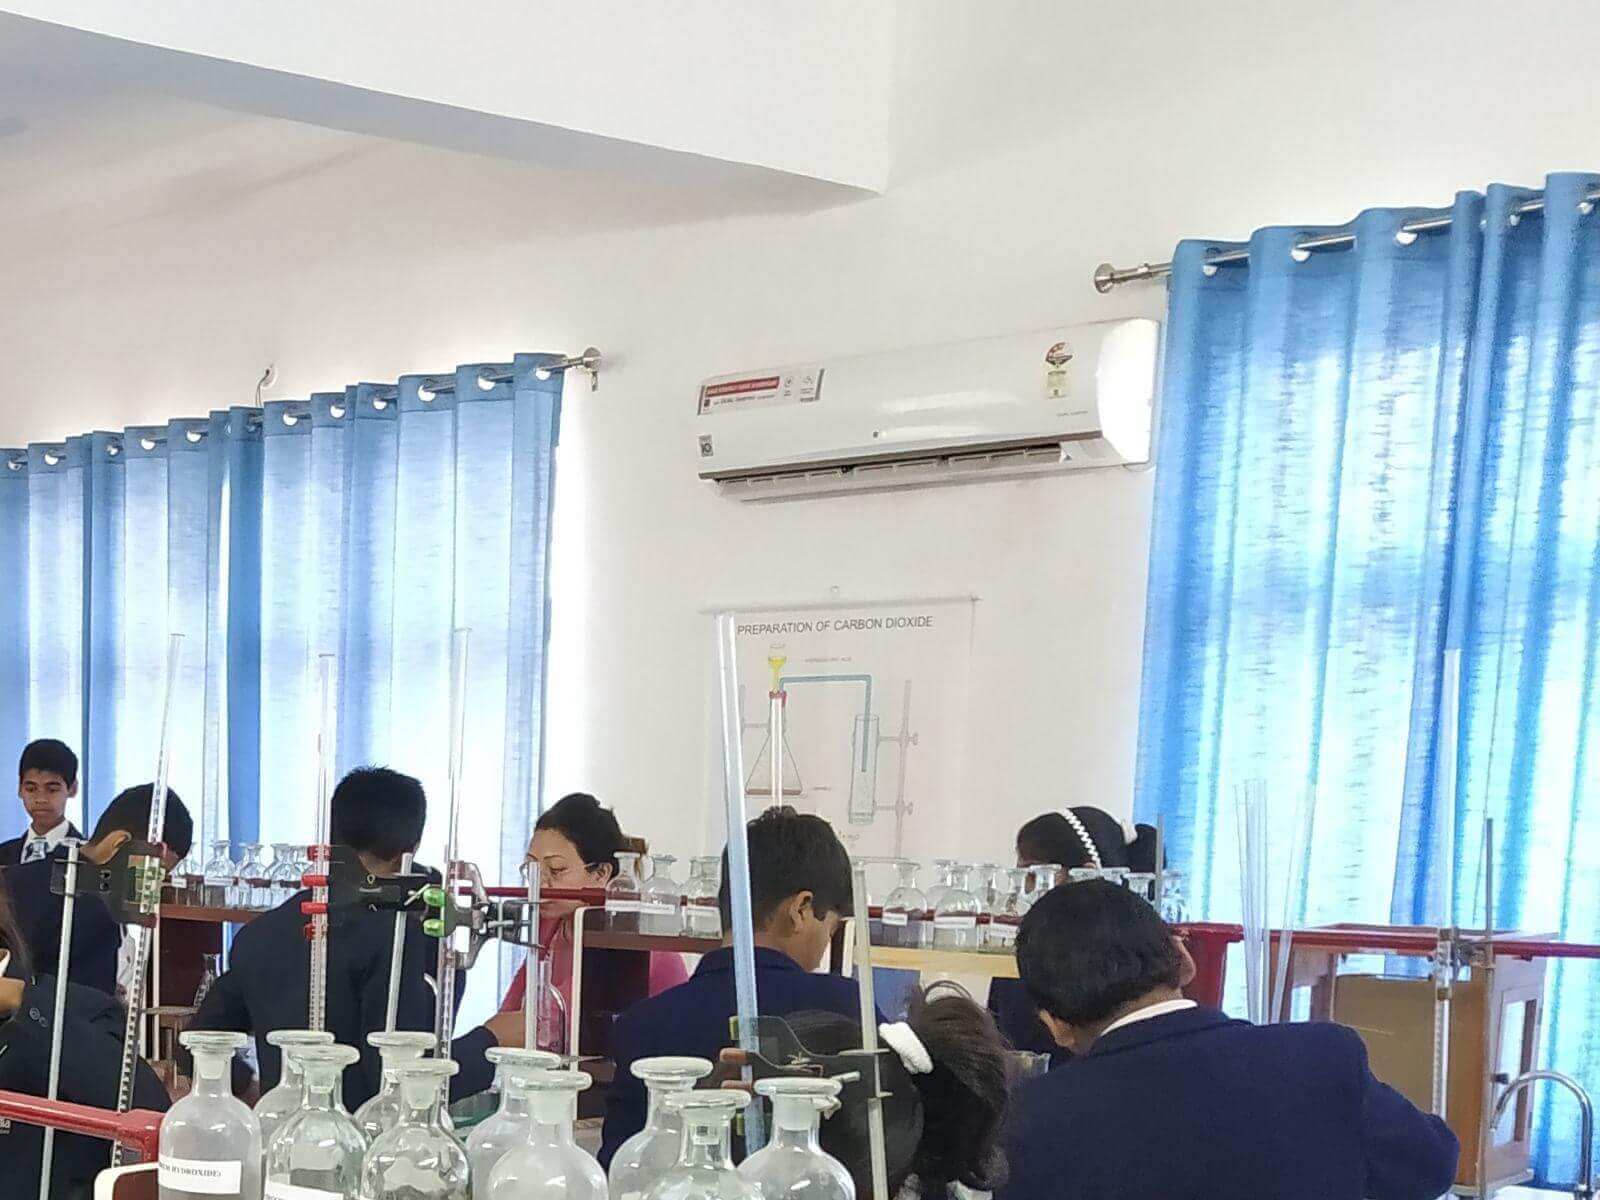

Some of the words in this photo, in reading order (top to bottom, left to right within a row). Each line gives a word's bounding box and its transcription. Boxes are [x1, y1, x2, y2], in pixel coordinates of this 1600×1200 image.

[737, 622, 812, 635] PREPARATION
[815, 621, 830, 632] OF
[834, 618, 882, 631] CARBON
[885, 616, 933, 629] DIOXIDE
